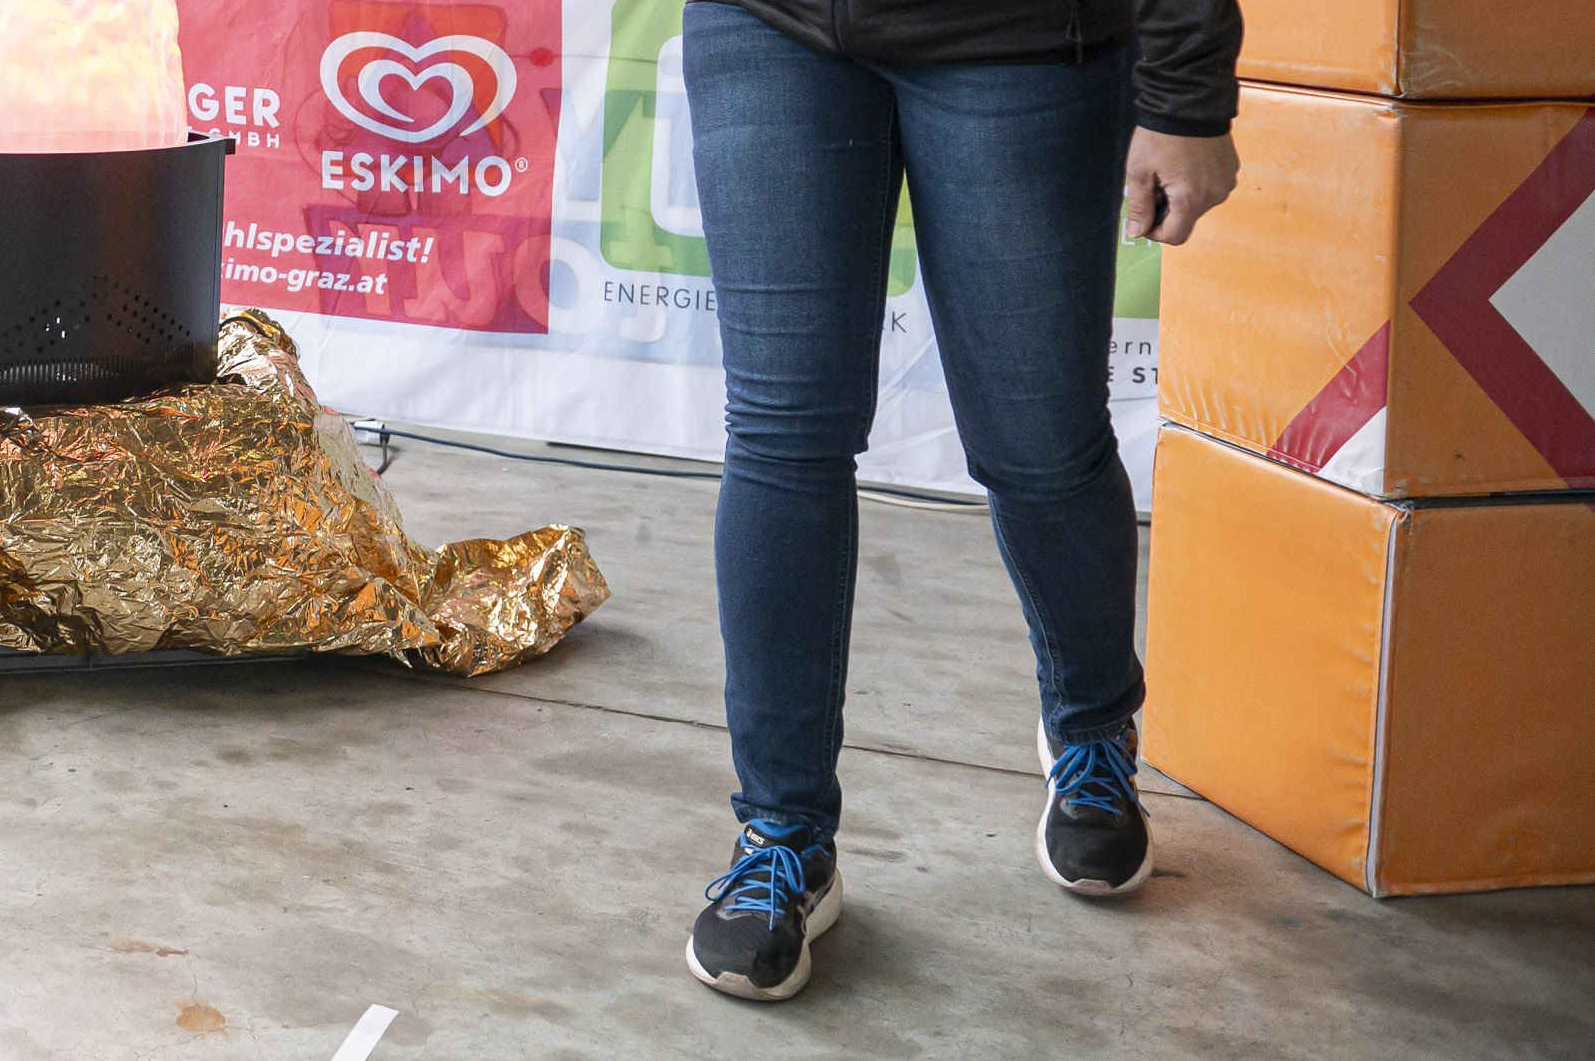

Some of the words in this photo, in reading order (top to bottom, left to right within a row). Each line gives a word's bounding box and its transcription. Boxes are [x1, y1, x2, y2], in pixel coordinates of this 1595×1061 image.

[188, 83, 281, 129] GER
[224, 220, 434, 264] hlspezialist!
[220, 257, 387, 295] imo-graz.at
